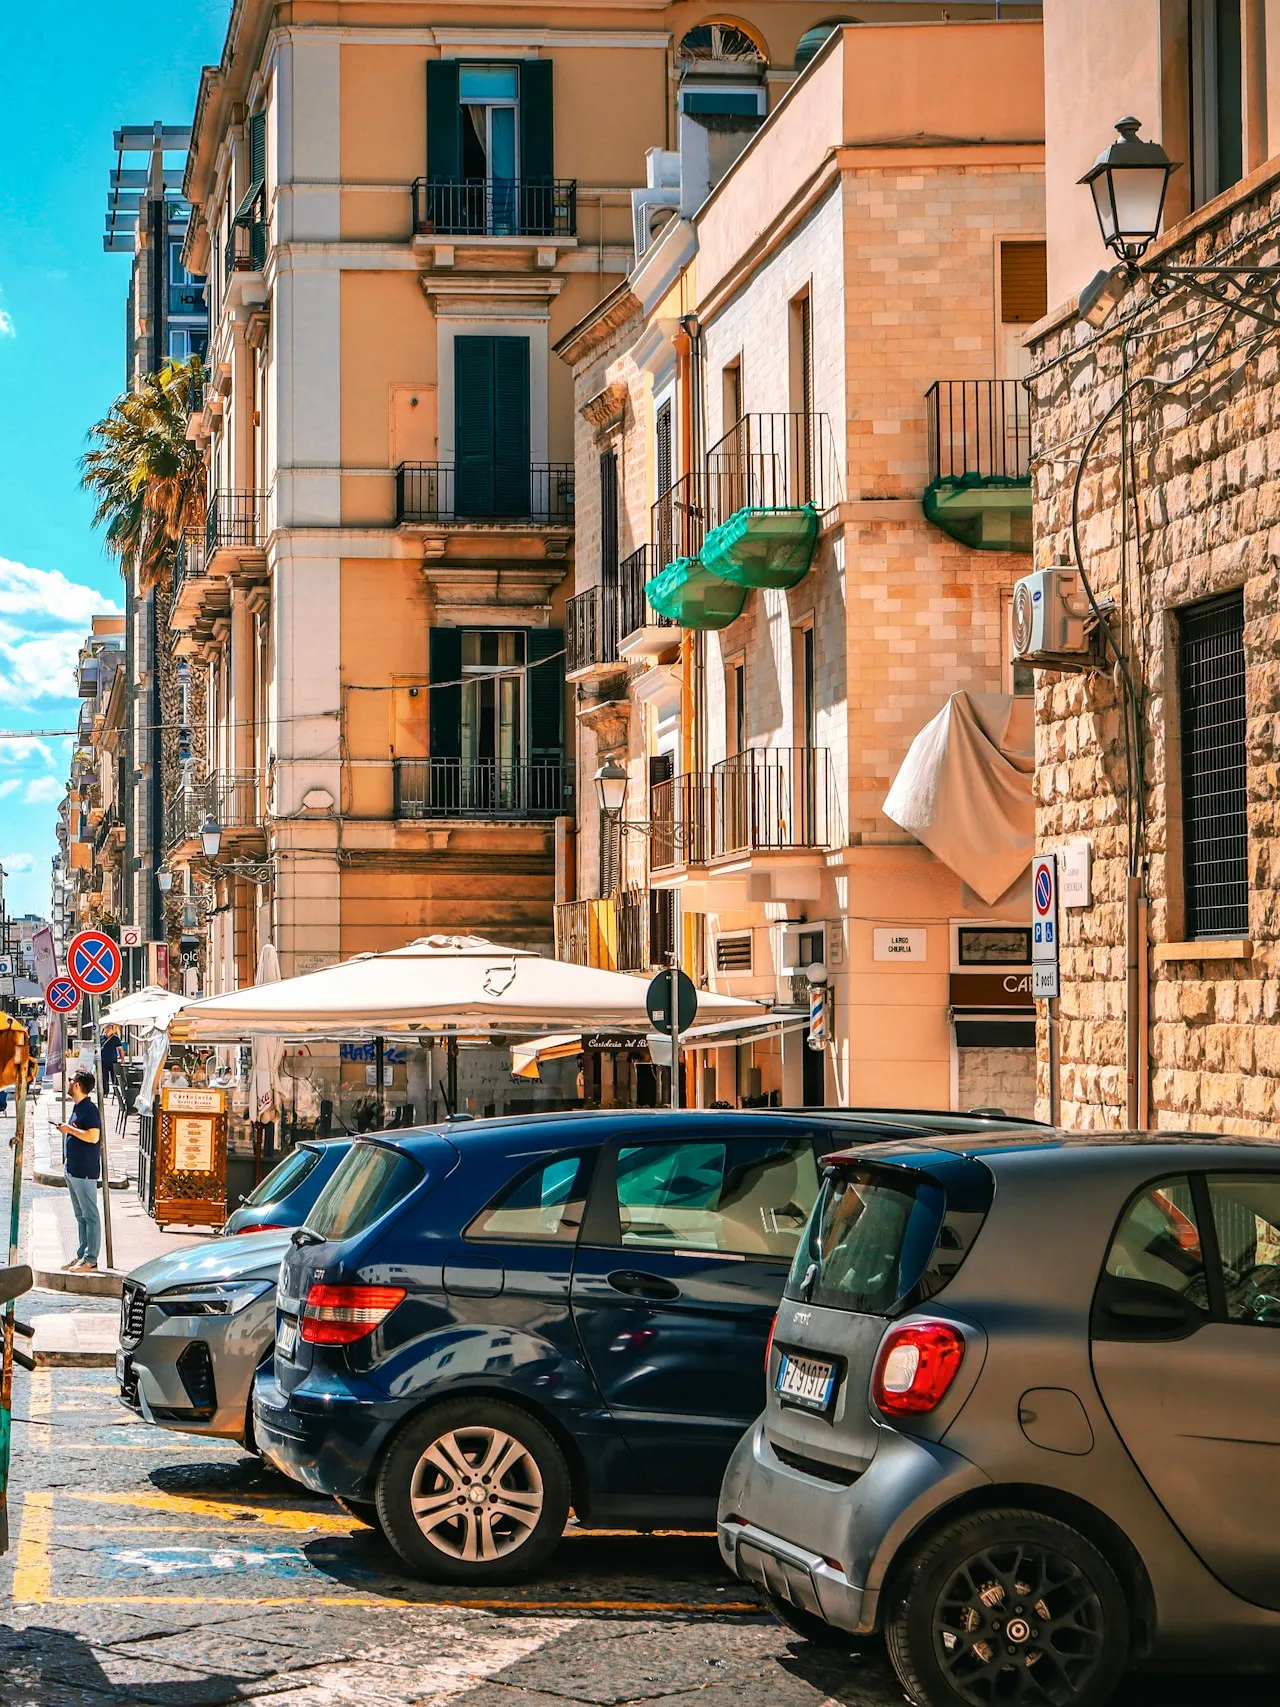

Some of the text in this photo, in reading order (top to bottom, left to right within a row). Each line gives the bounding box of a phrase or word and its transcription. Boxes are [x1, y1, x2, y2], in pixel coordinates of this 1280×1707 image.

[1035, 971, 1054, 988] 2 posti
[782, 1357, 830, 1398] FZ 919TZ
